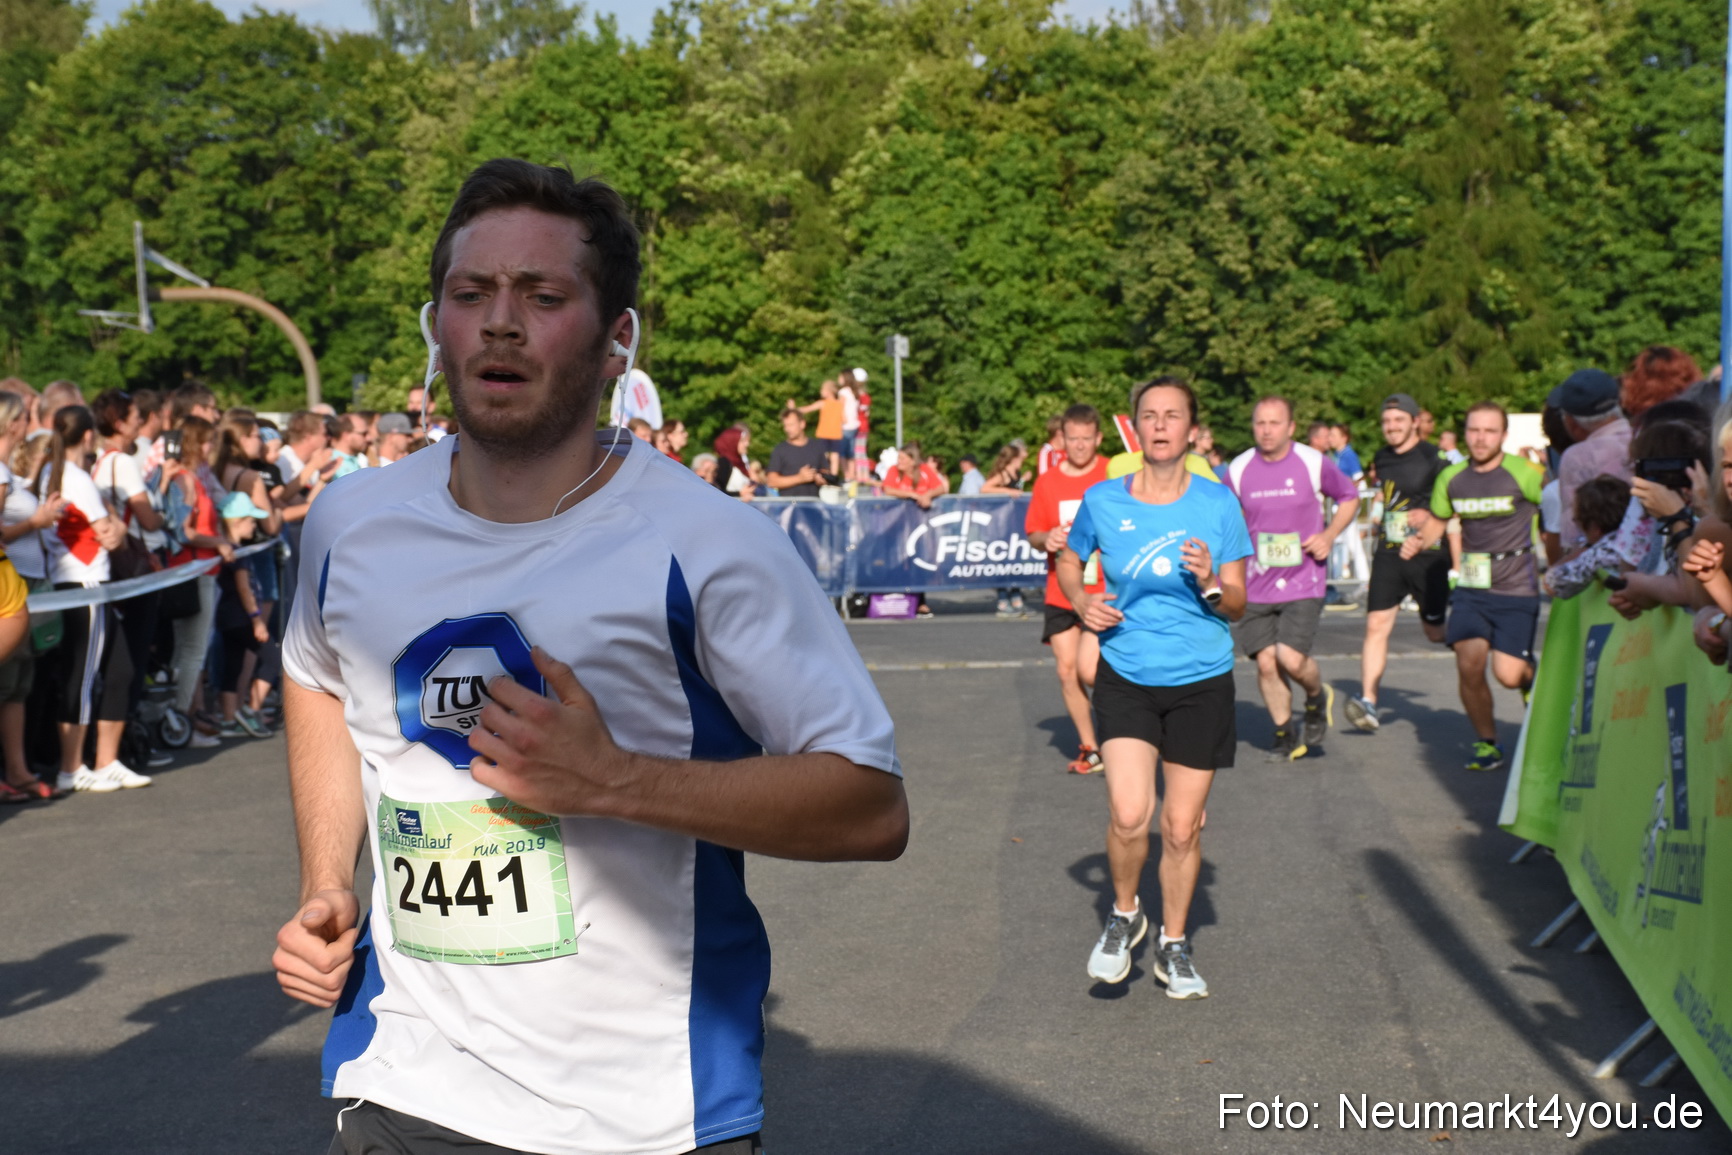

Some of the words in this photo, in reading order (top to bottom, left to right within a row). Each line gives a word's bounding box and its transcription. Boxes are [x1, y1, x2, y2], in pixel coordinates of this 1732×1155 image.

[391, 827, 453, 850] firmenlauf
[506, 836, 546, 854] 2019
[393, 855, 529, 917] 2441
